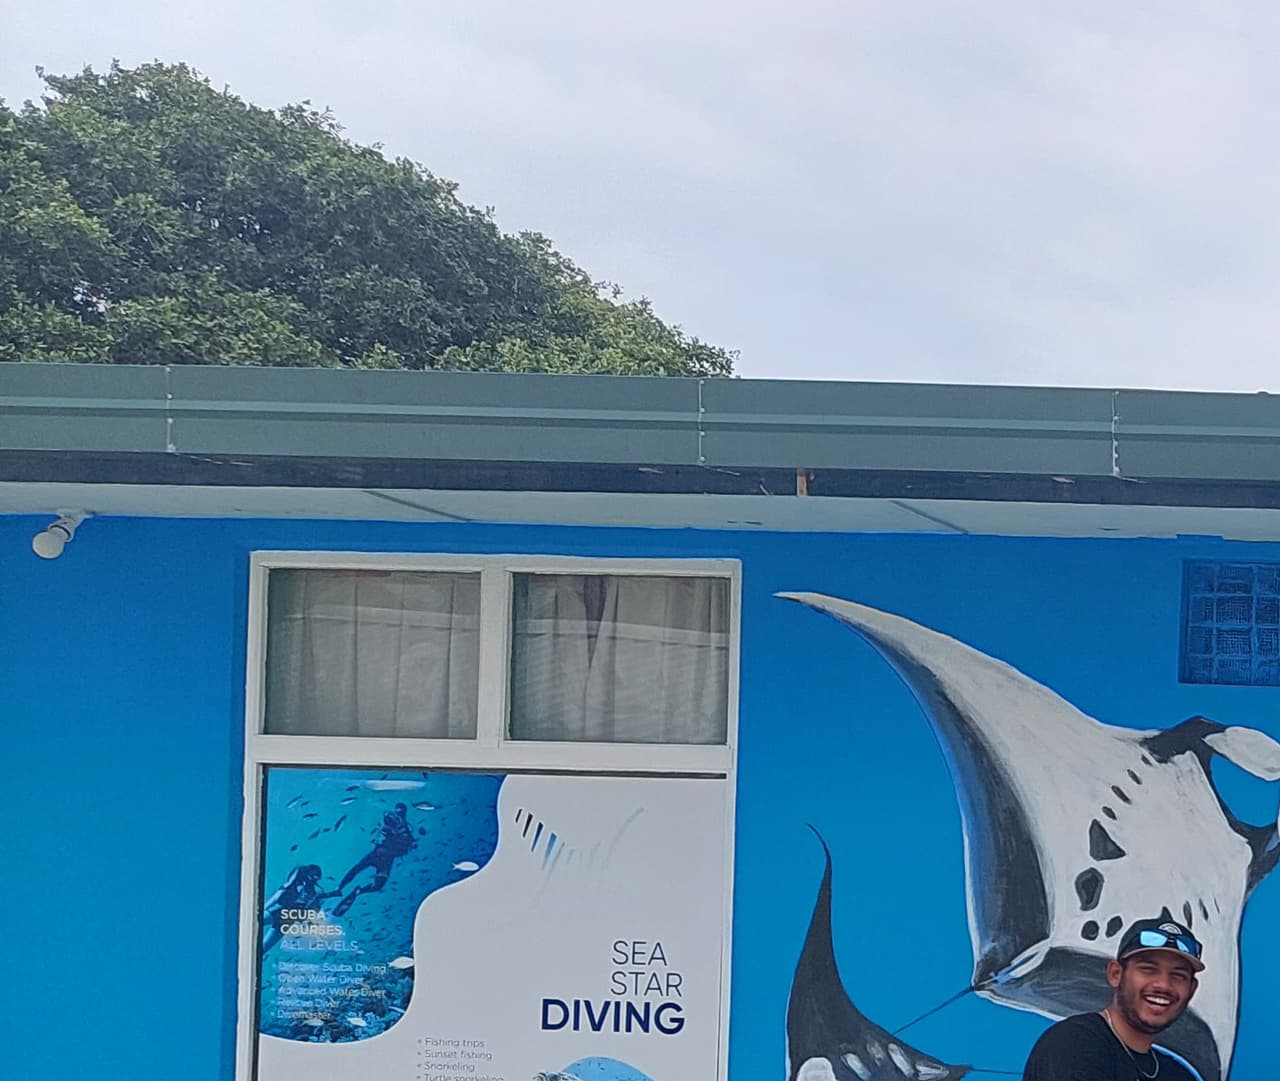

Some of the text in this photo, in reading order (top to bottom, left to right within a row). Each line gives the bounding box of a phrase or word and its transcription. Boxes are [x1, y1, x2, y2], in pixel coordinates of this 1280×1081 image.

[280, 909, 326, 920] SCUBA
[280, 939, 305, 950] ALL
[611, 940, 668, 967] SEA
[322, 963, 352, 973] Scuba
[355, 963, 387, 975] Diving
[610, 970, 683, 997] STAR
[541, 998, 686, 1035] DIVING
[425, 1037, 485, 1048] Fishing trips
[424, 1049, 492, 1061] Sunset fishing
[424, 1061, 475, 1072] Snorkeling
